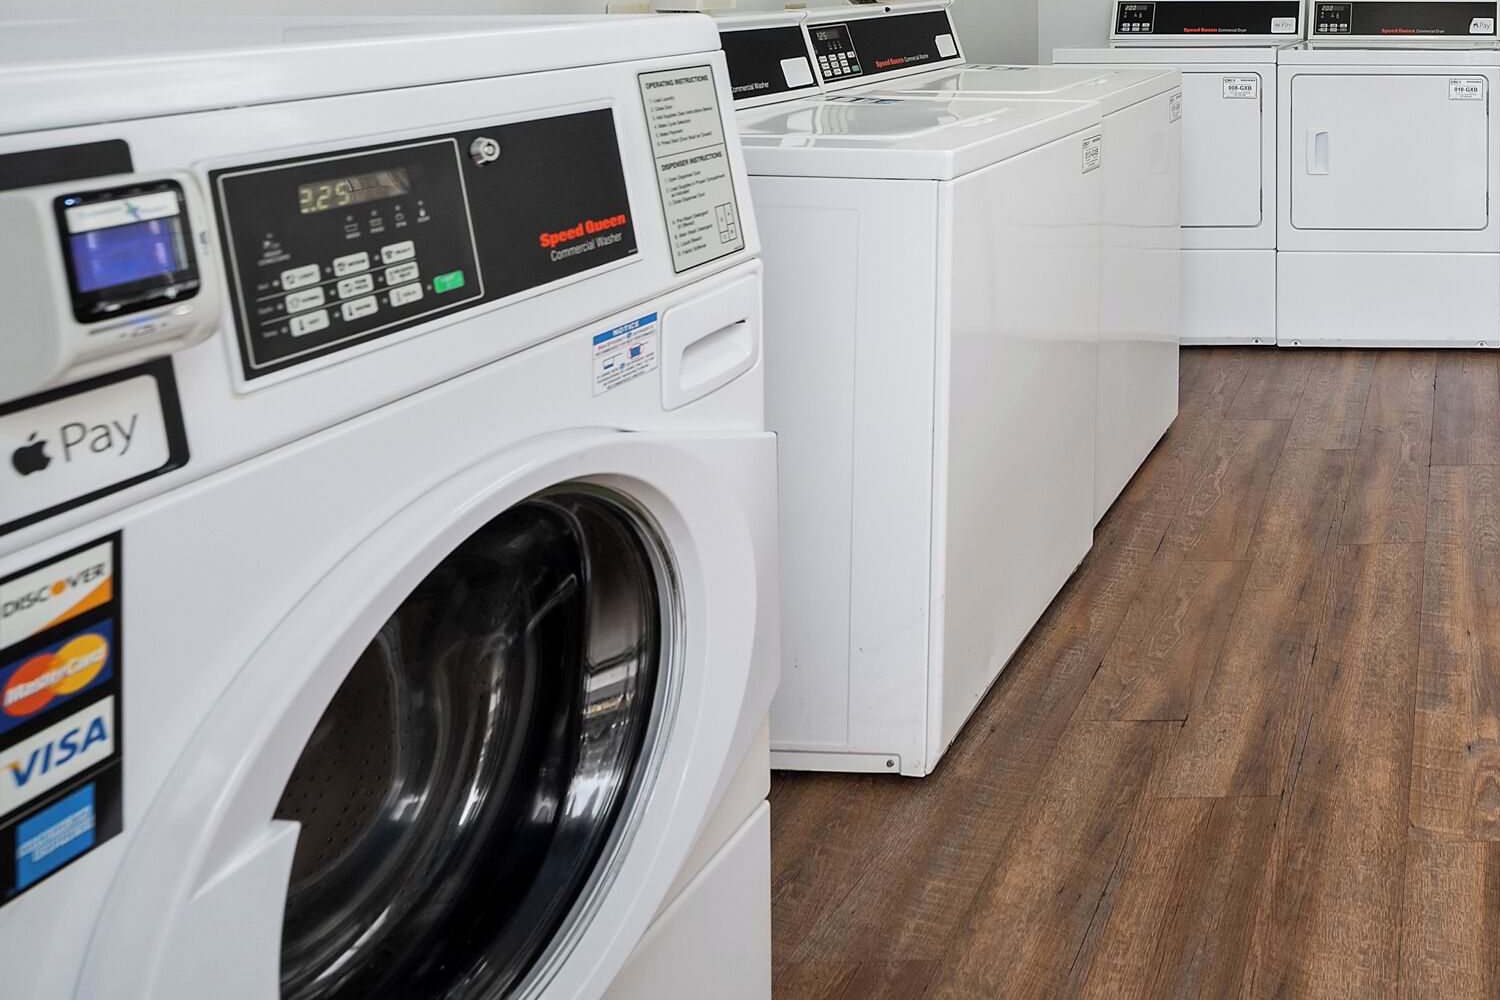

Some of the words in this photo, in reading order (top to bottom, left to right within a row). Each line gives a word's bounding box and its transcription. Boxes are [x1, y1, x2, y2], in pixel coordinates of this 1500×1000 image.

[1480, 22, 1491, 30] Pay
[875, 59, 891, 69] Speed
[645, 80, 674, 90] OPERATING
[675, 75, 709, 86] INSTRUCTIONS
[661, 159, 689, 172] DISPENSER
[690, 151, 723, 165] INSTRUCTIONS
[540, 222, 585, 248] Speed
[585, 214, 627, 234] Queen
[550, 239, 596, 262] Commercial
[596, 232, 623, 248] Washer
[612, 320, 640, 336] NOTICE
[61, 414, 138, 463] Pay
[1, 562, 106, 619] DISCOVER
[4, 645, 106, 705] MasterCard
[5, 714, 108, 788] VISA
